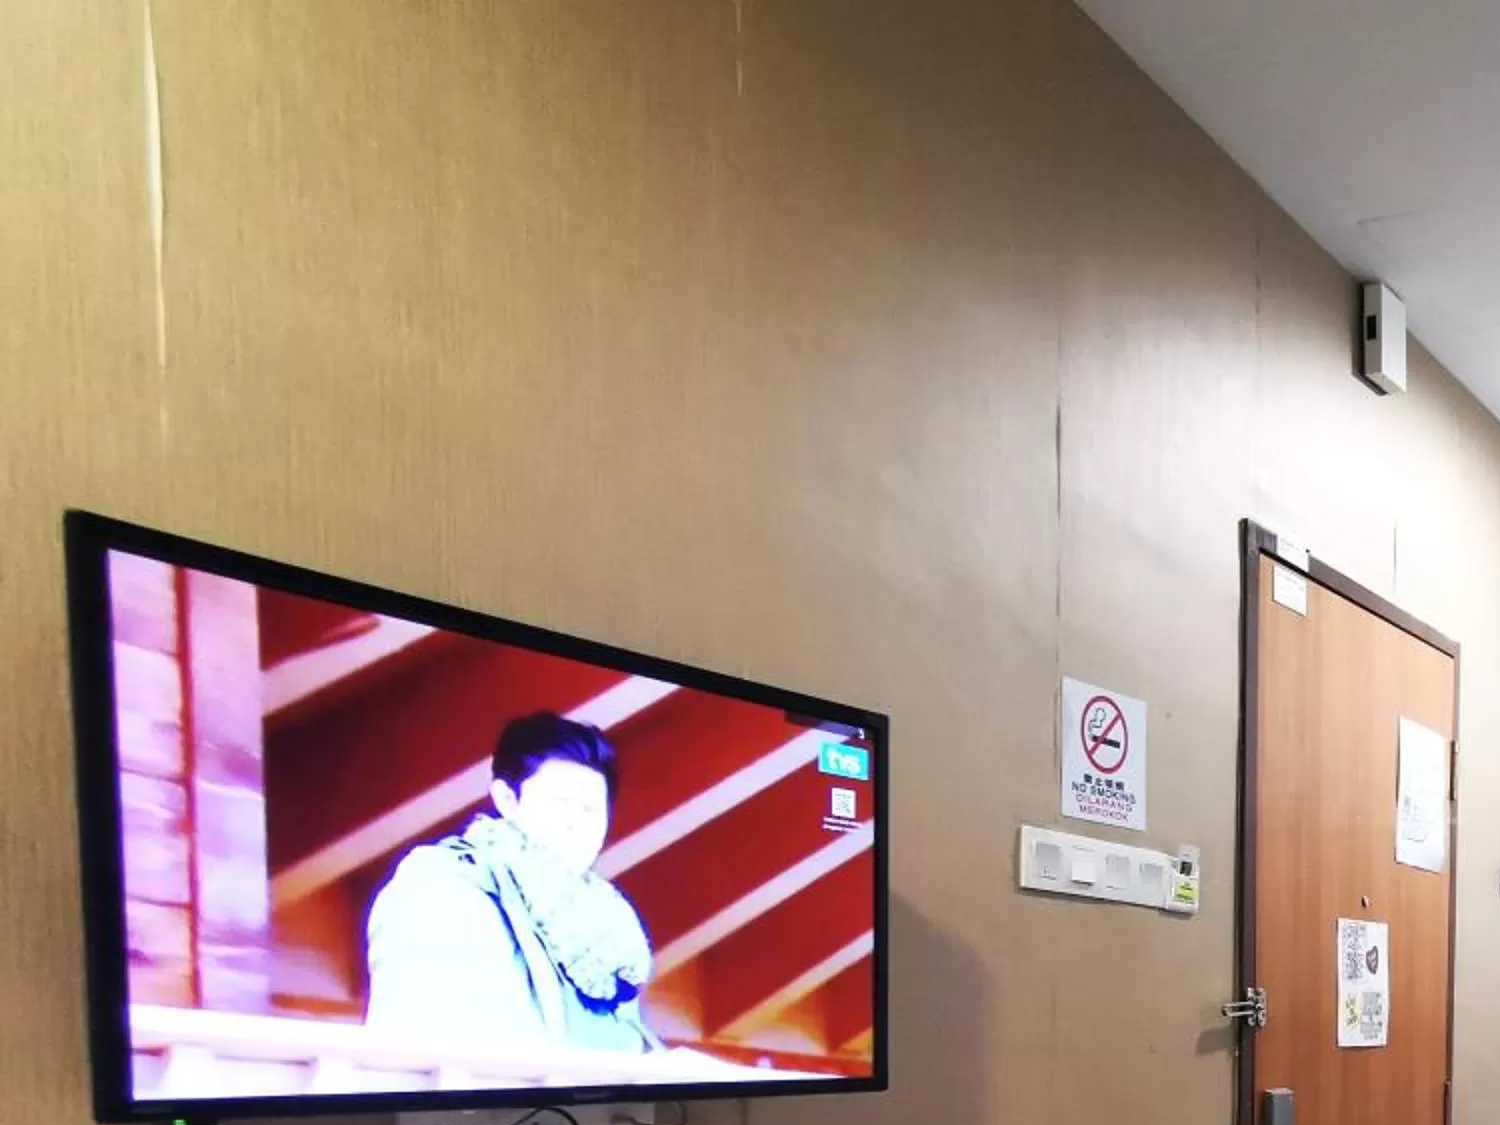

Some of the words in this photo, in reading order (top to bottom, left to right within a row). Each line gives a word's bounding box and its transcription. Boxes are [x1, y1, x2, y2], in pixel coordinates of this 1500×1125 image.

[1071, 781, 1087, 794] NO
[1090, 785, 1137, 805] SMOKING
[1075, 793, 1133, 813] DILARANG
[1079, 804, 1129, 823] MEROKOK
